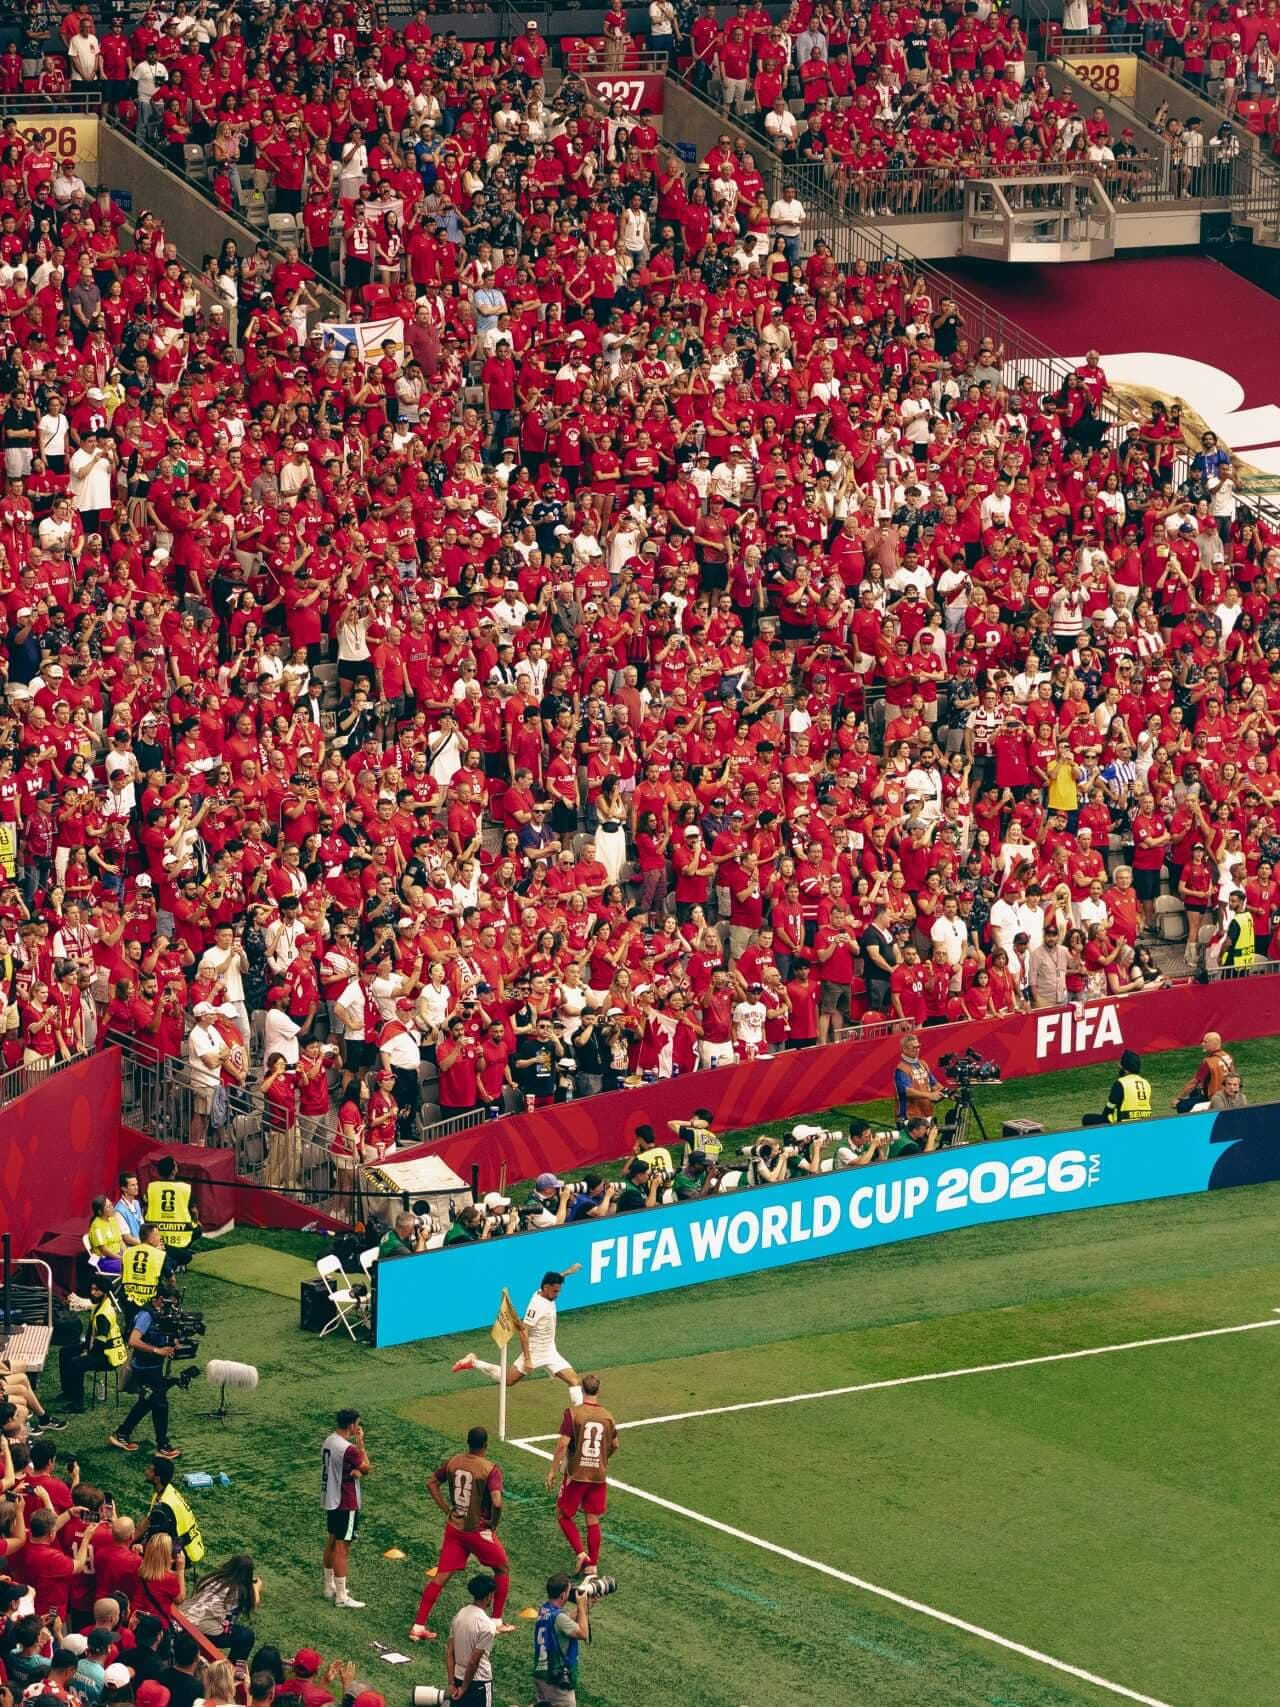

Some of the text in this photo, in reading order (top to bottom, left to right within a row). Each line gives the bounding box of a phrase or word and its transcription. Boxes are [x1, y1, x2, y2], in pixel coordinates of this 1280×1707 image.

[596, 80, 644, 112] 227
[456, 957, 474, 997] OUGS
[1036, 1004, 1123, 1058] FIFA
[159, 1223, 186, 1231] CURITY
[591, 1227, 682, 1284] FIFA
[690, 1190, 841, 1262] WORLD
[849, 1177, 929, 1230] CUP
[936, 1150, 1087, 1212] 2026
